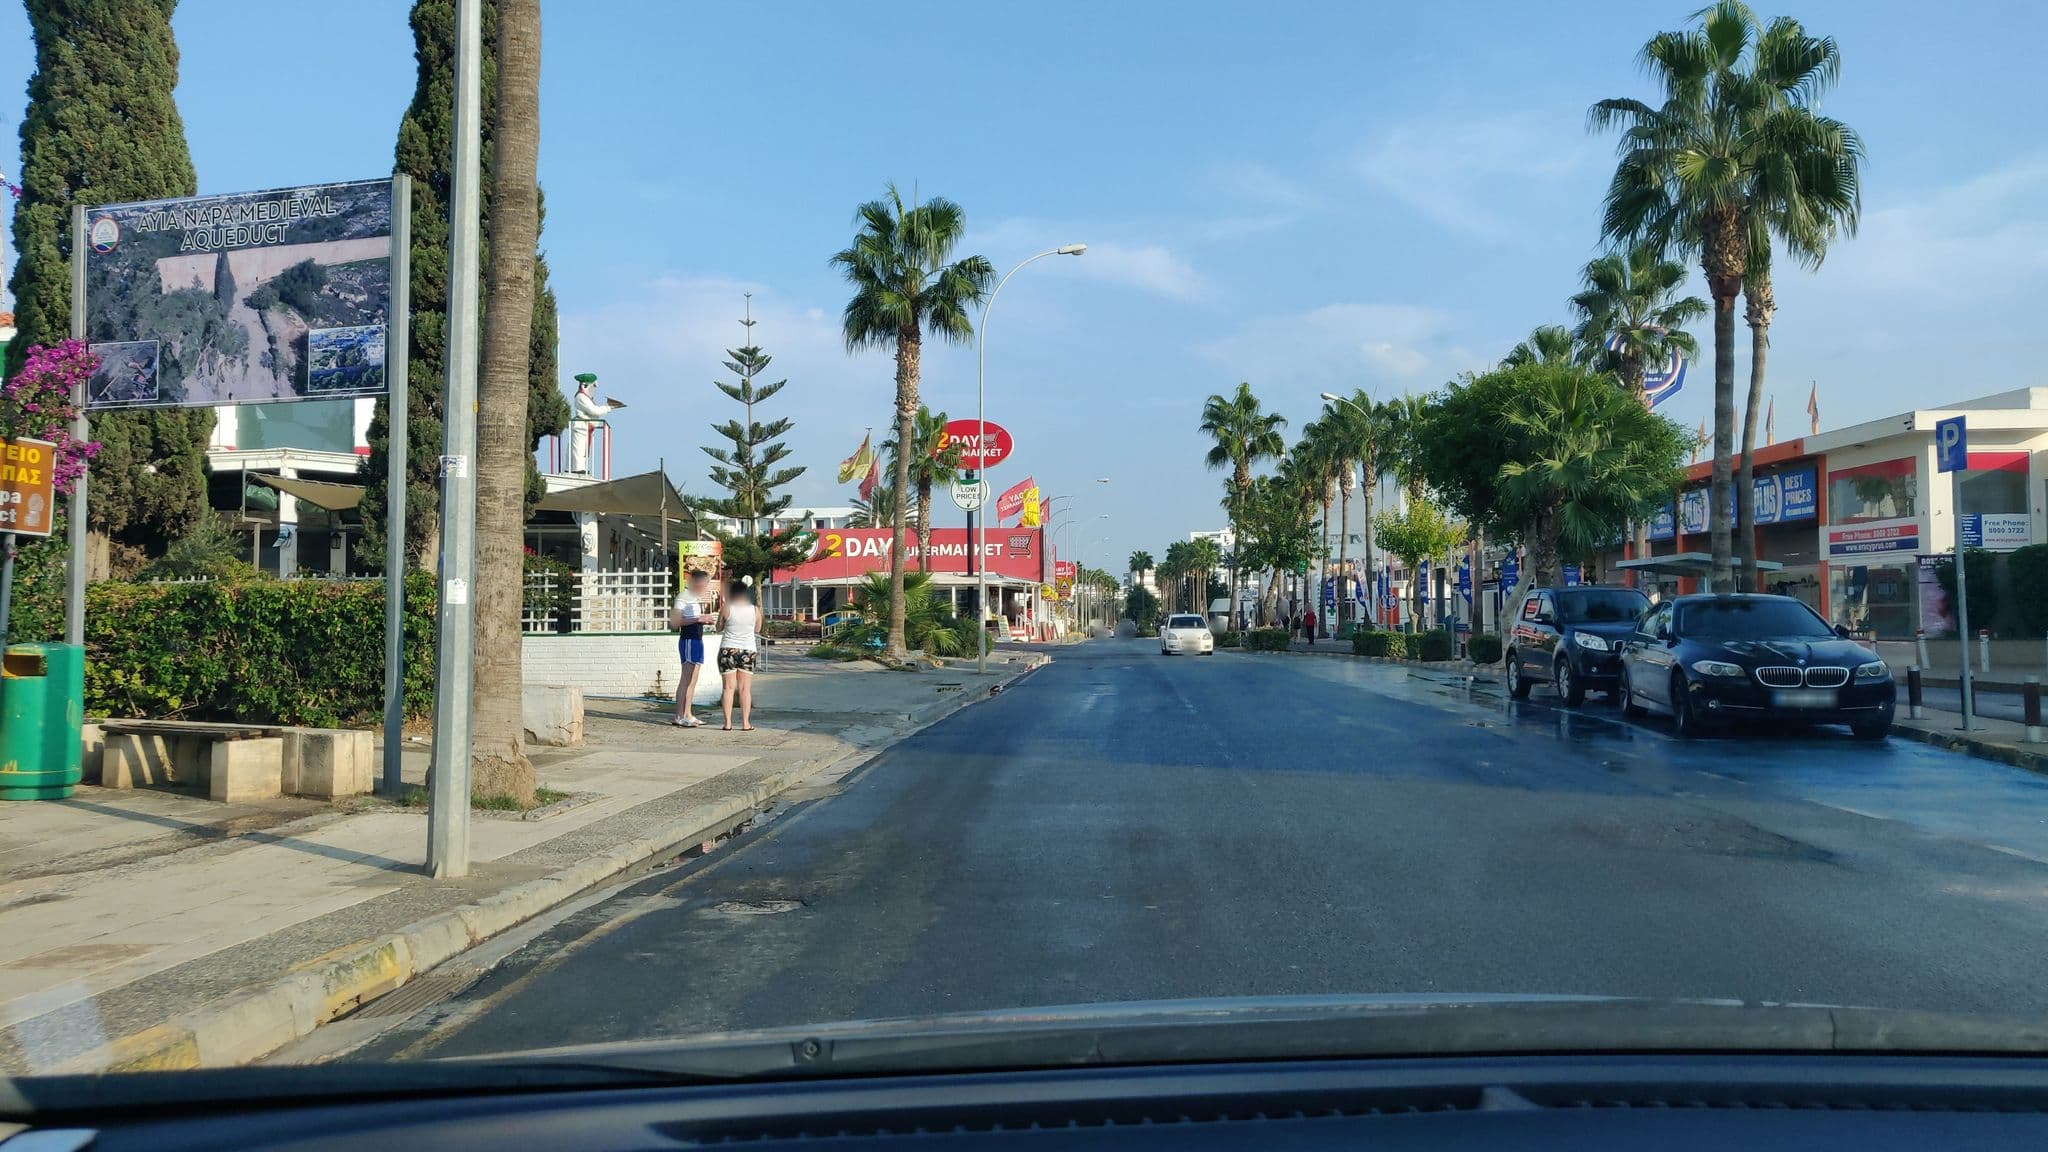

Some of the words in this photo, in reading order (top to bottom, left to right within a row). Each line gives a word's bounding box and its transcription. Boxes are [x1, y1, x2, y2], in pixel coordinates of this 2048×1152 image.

[137, 211, 179, 232] AYIA
[184, 207, 234, 228] NAPA
[239, 196, 337, 223] MEDIEVAL
[180, 223, 289, 252] AQUEDUCT
[1942, 422, 1960, 461] P
[1784, 474, 1804, 490] BEST
[1785, 488, 1812, 505] PRICES
[1753, 485, 1776, 516] PLUS
